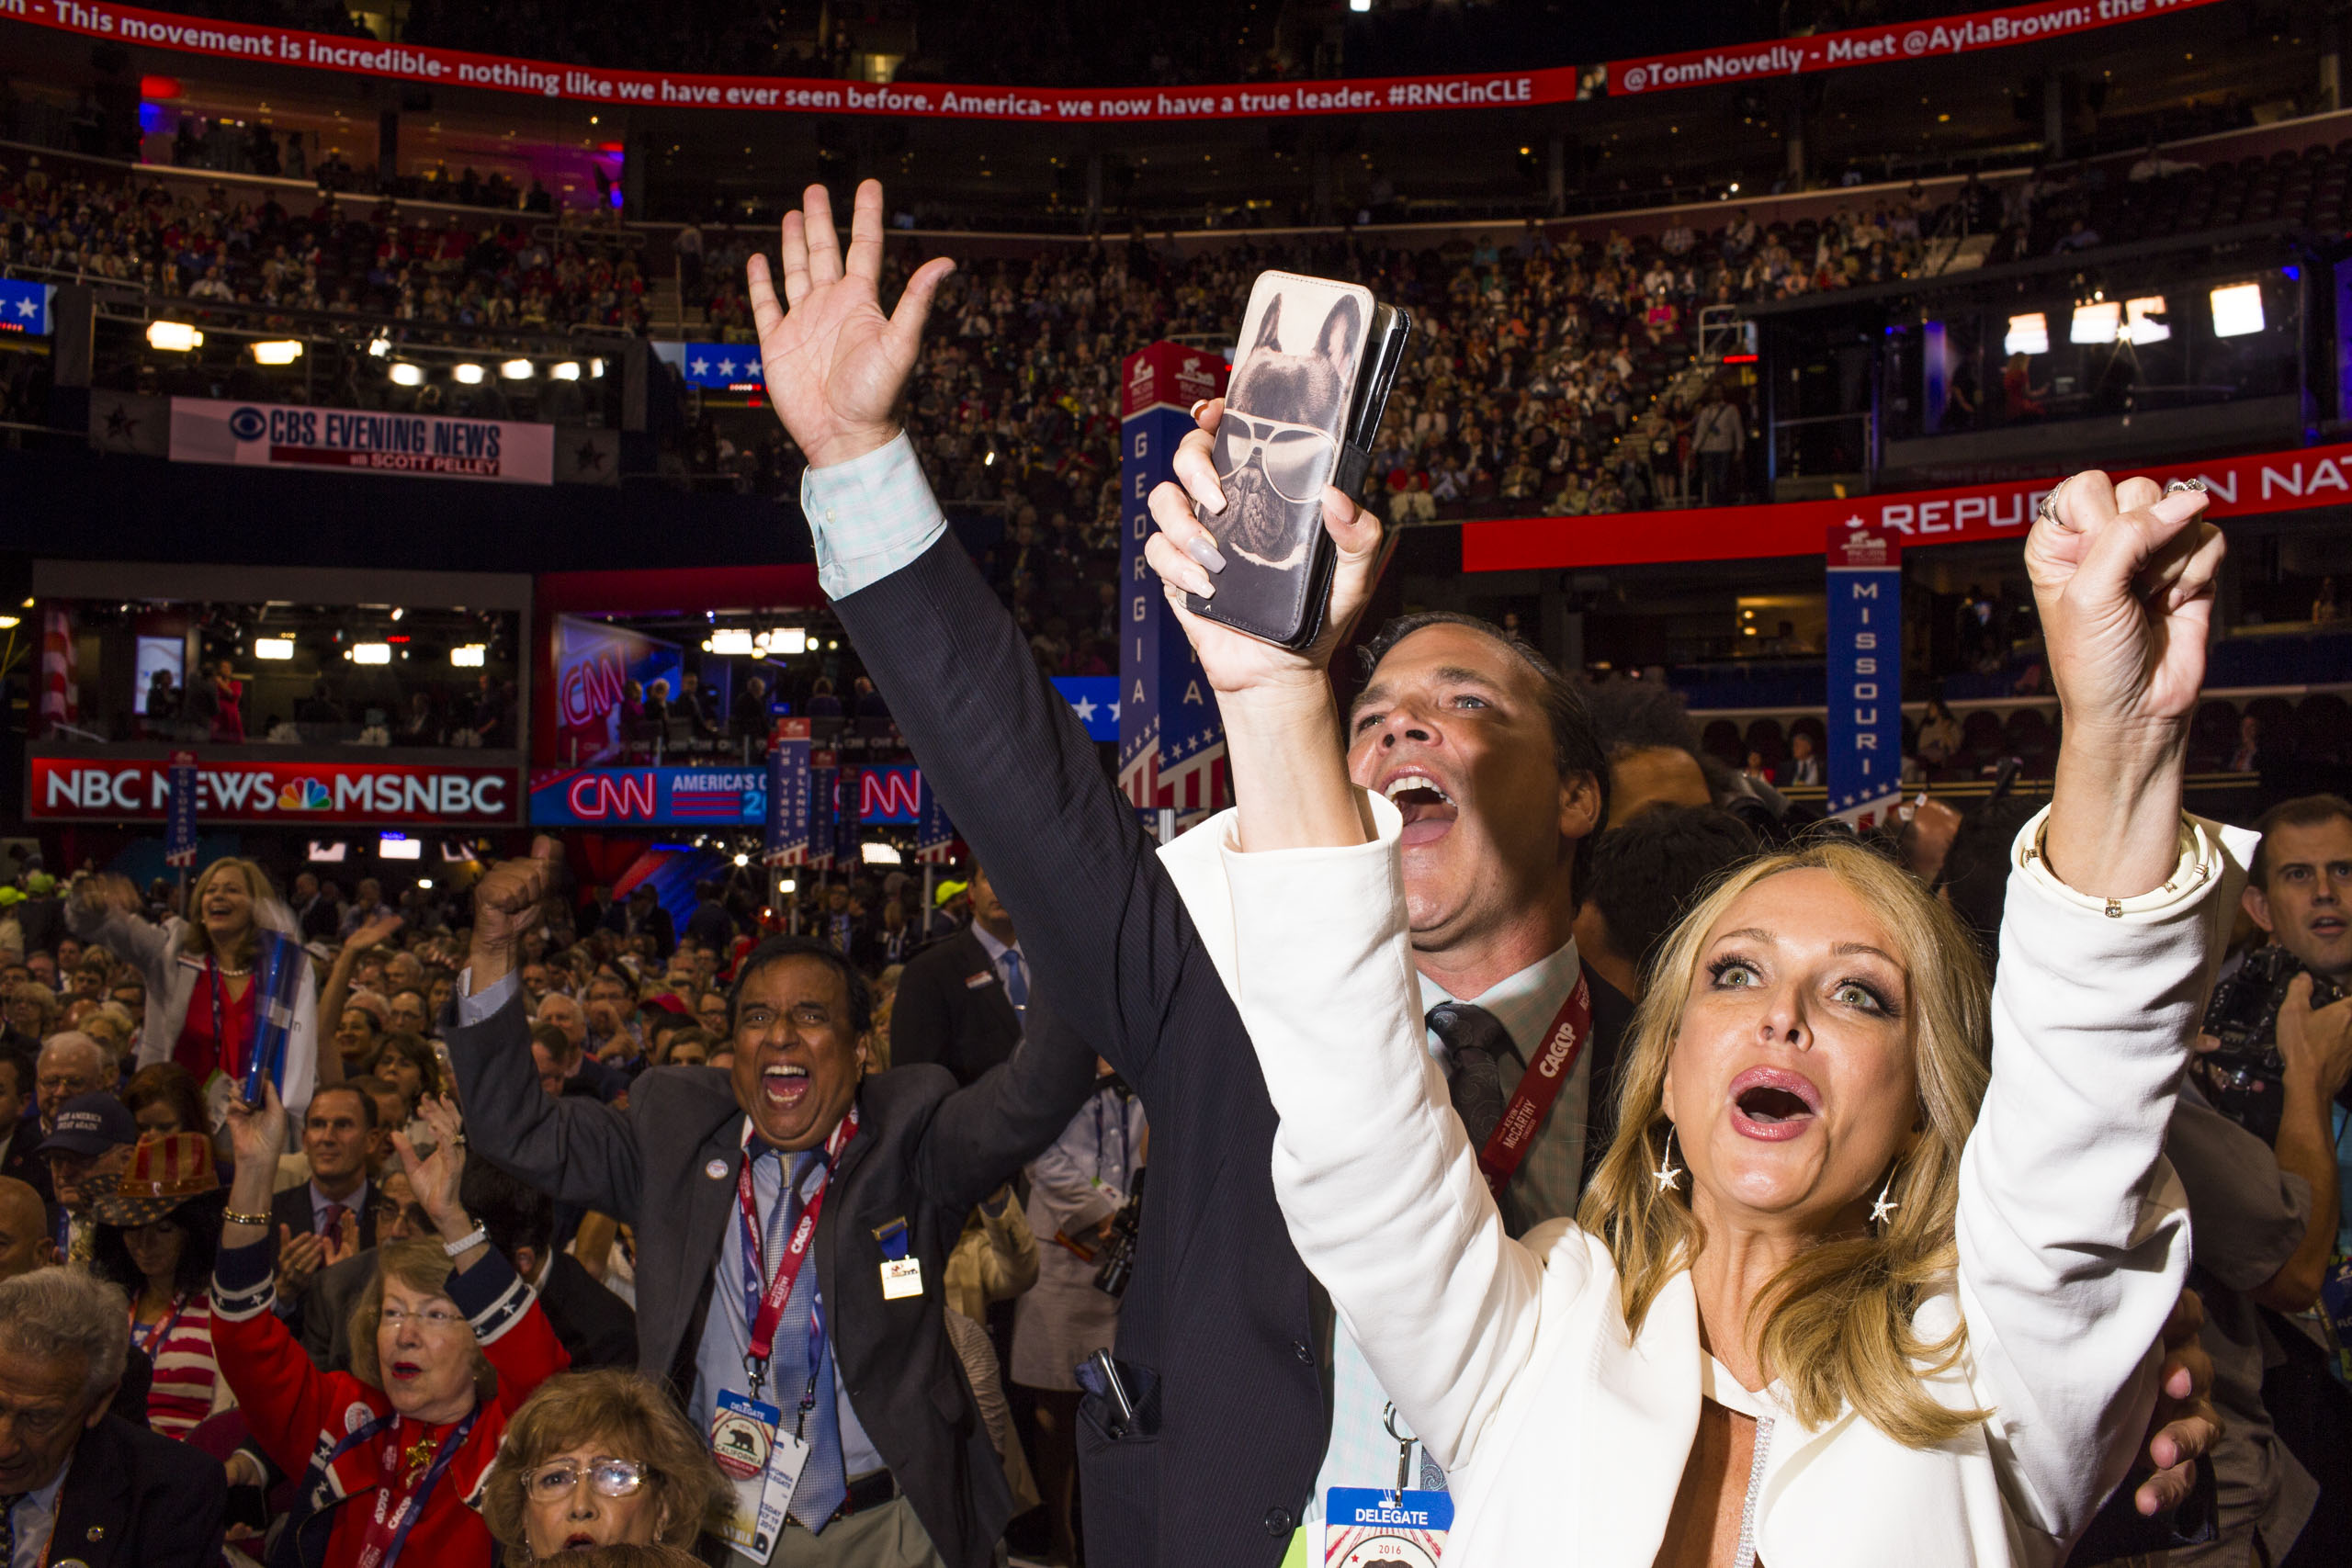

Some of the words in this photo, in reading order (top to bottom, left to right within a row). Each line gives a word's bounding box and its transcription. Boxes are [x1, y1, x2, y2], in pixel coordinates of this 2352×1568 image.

[52, 0, 113, 32] This
[120, 17, 273, 57] movement
[279, 35, 301, 59] is
[308, 39, 451, 77] incredible-
[458, 63, 560, 95] nothing
[565, 72, 611, 99] like
[617, 81, 655, 99] we
[661, 79, 719, 103] have
[725, 87, 779, 105] ever
[784, 88, 841, 107] seen
[846, 85, 933, 111] before.
[940, 91, 1051, 116] America-
[1057, 100, 1093, 117] we
[1099, 99, 1151, 117] now
[1157, 93, 1215, 115] have
[1220, 96, 1234, 112] a
[1238, 92, 1291, 112] true
[1296, 85, 1381, 109] leader.
[1387, 78, 1532, 106] #RNCinCLE
[1623, 46, 1804, 90] @TomNovelly
[1826, 33, 1896, 62] Meet
[1902, 6, 2091, 54] @AylaBrown:
[270, 410, 316, 445] CBS
[325, 414, 425, 452] EVENING
[435, 422, 501, 457] NEWS
[371, 454, 429, 470] SCOTT
[433, 458, 498, 475] PELLEY
[1133, 432, 1148, 703] GEORGIA
[1853, 583, 1877, 774] MISSOURI
[46, 769, 141, 809] NBC
[334, 773, 506, 814] MSNBC
[568, 773, 655, 819] CNN
[673, 773, 755, 793] AMERICA'S
[1539, 1021, 1577, 1079] CAGOP
[1503, 1107, 1519, 1128] KEVIN
[791, 1214, 812, 1254] CAGOP
[730, 1402, 765, 1421] DELEGATE
[715, 1443, 761, 1466] CALIFORNIA
[1355, 1508, 1429, 1526] DELEGATE
[1379, 1544, 1402, 1555] 2016
